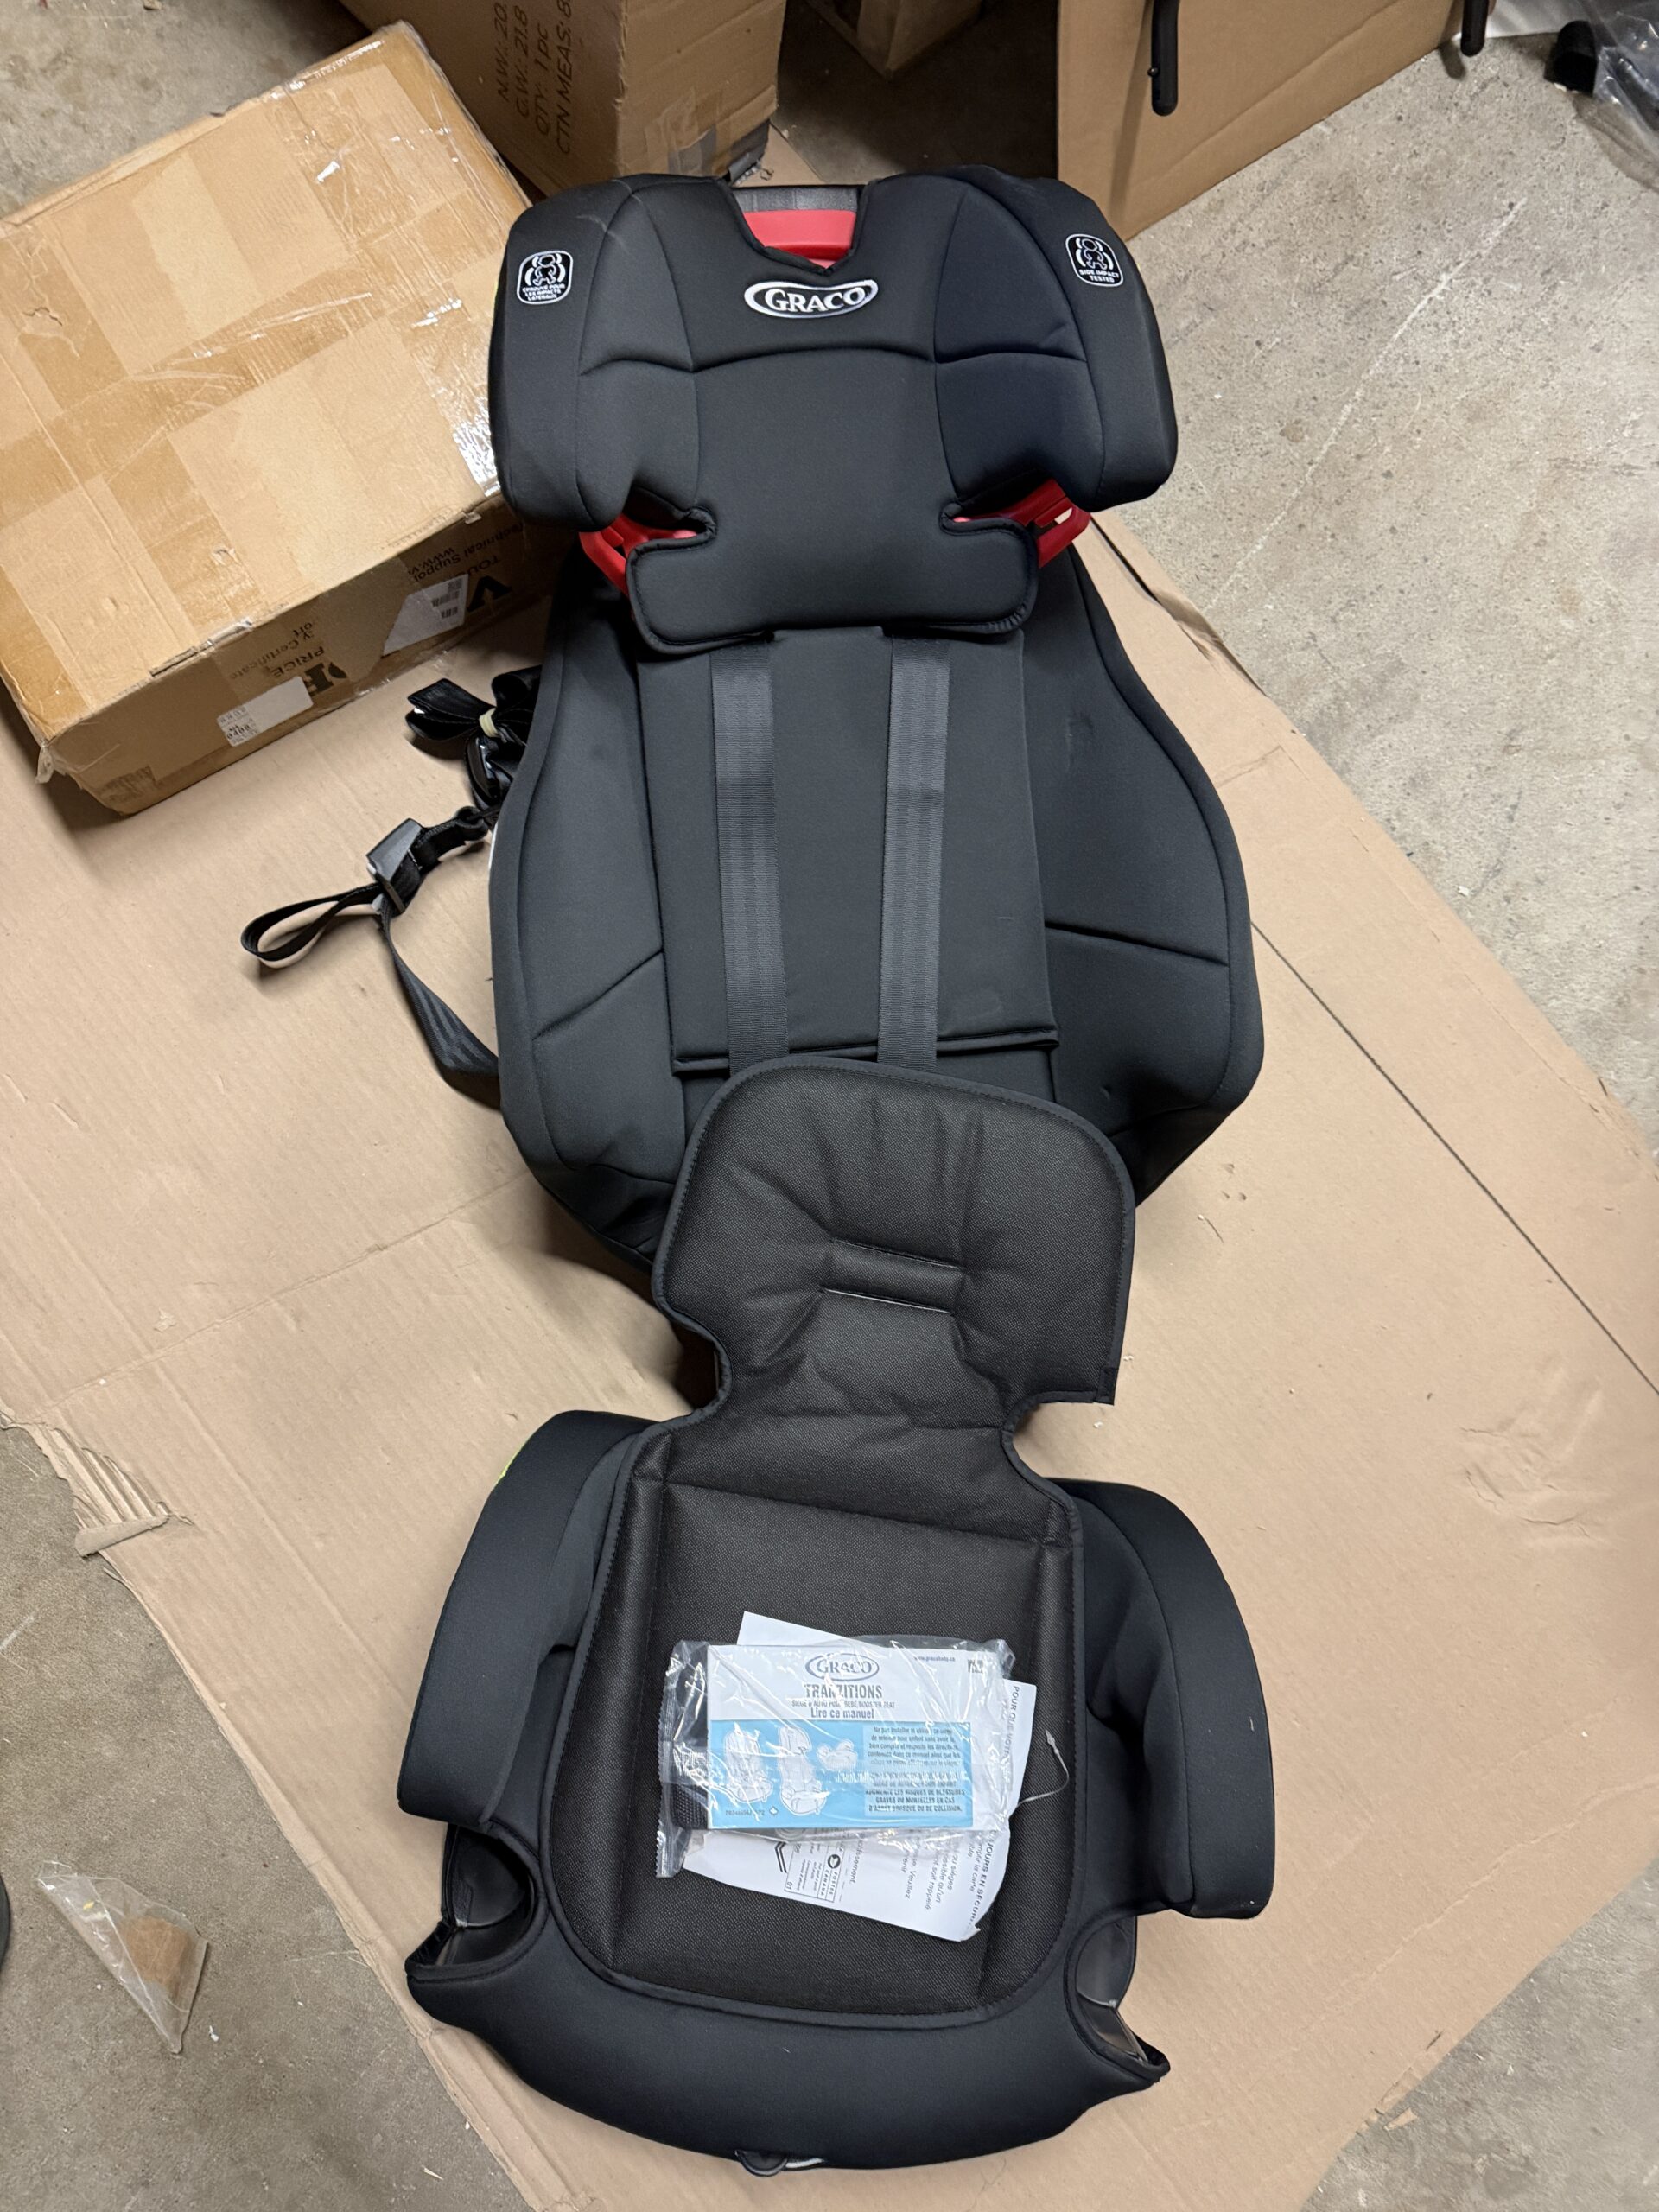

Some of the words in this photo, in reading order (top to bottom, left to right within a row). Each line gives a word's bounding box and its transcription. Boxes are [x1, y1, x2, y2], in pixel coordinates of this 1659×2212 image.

[556, 22, 573, 104] MEAS:
[556, 104, 571, 155] CTN
[1095, 270, 1119, 278] IMPACT
[765, 287, 866, 313] GRACO
[229, 639, 300, 680] Certificate
[270, 645, 326, 679] PRICE
[816, 1658, 873, 1675] GRACO
[1010, 1685, 1020, 1711] POUR
[810, 1707, 828, 1718] Lire
[830, 1709, 841, 1718] ce
[842, 1708, 874, 1719] manuel
[1007, 1712, 1016, 1730] QUE
[820, 1869, 830, 1897] CANADA
[905, 1869, 917, 1899] Veuillez
[979, 1874, 988, 1888] EN
